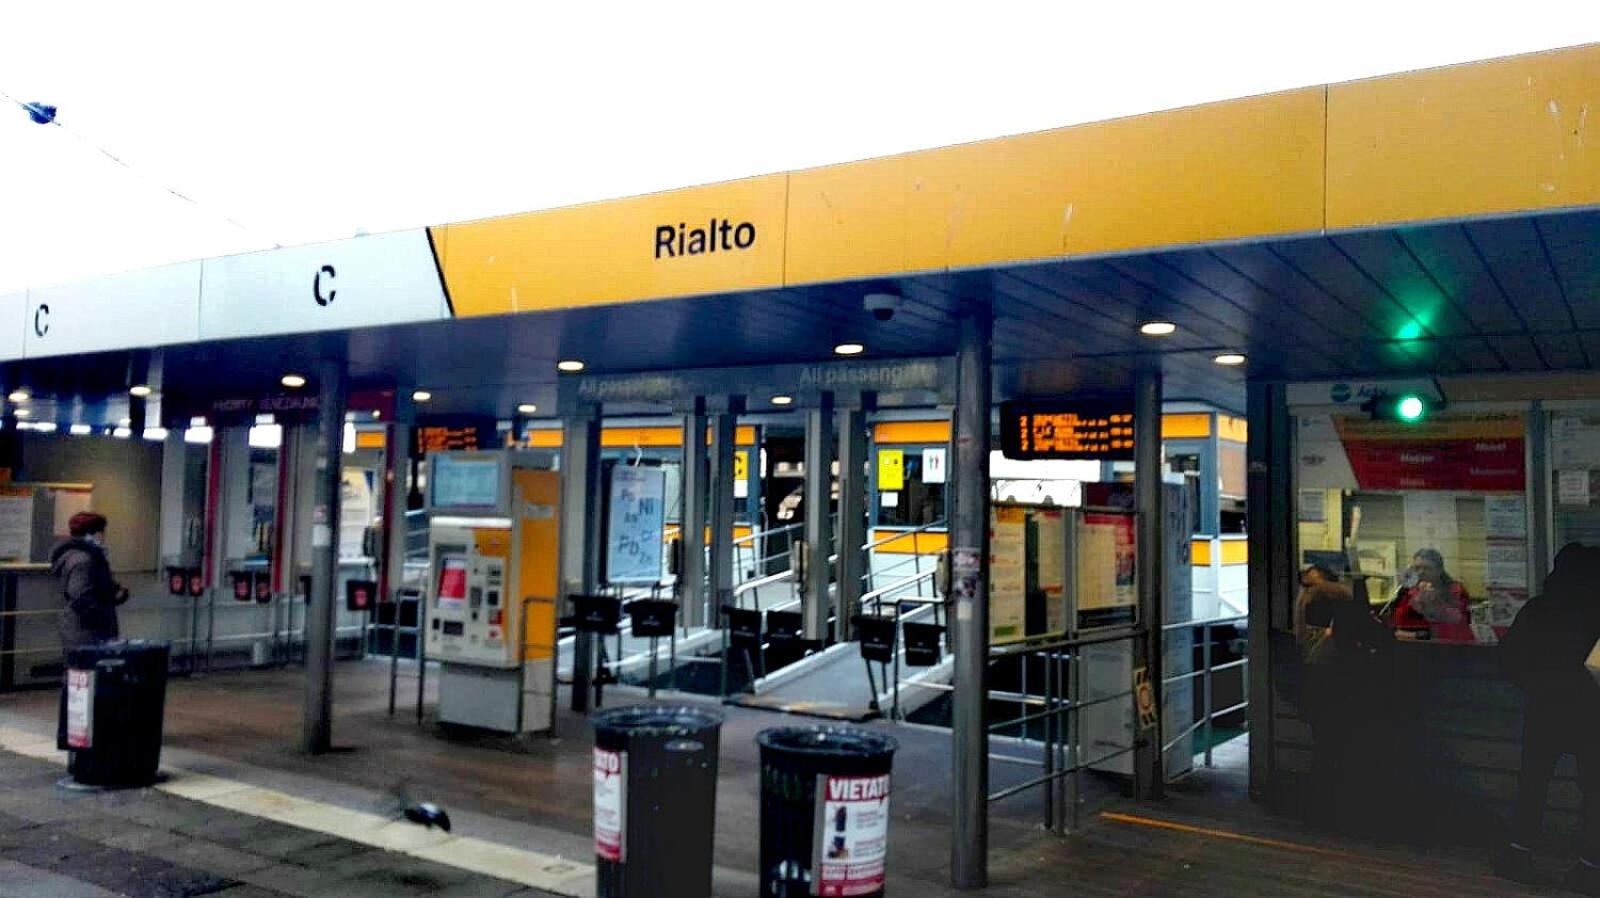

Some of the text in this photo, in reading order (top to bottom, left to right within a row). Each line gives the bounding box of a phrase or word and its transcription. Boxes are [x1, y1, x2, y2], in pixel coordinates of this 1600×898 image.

[655, 217, 756, 259] Rialto
[313, 264, 337, 307] C
[34, 303, 50, 338] C
